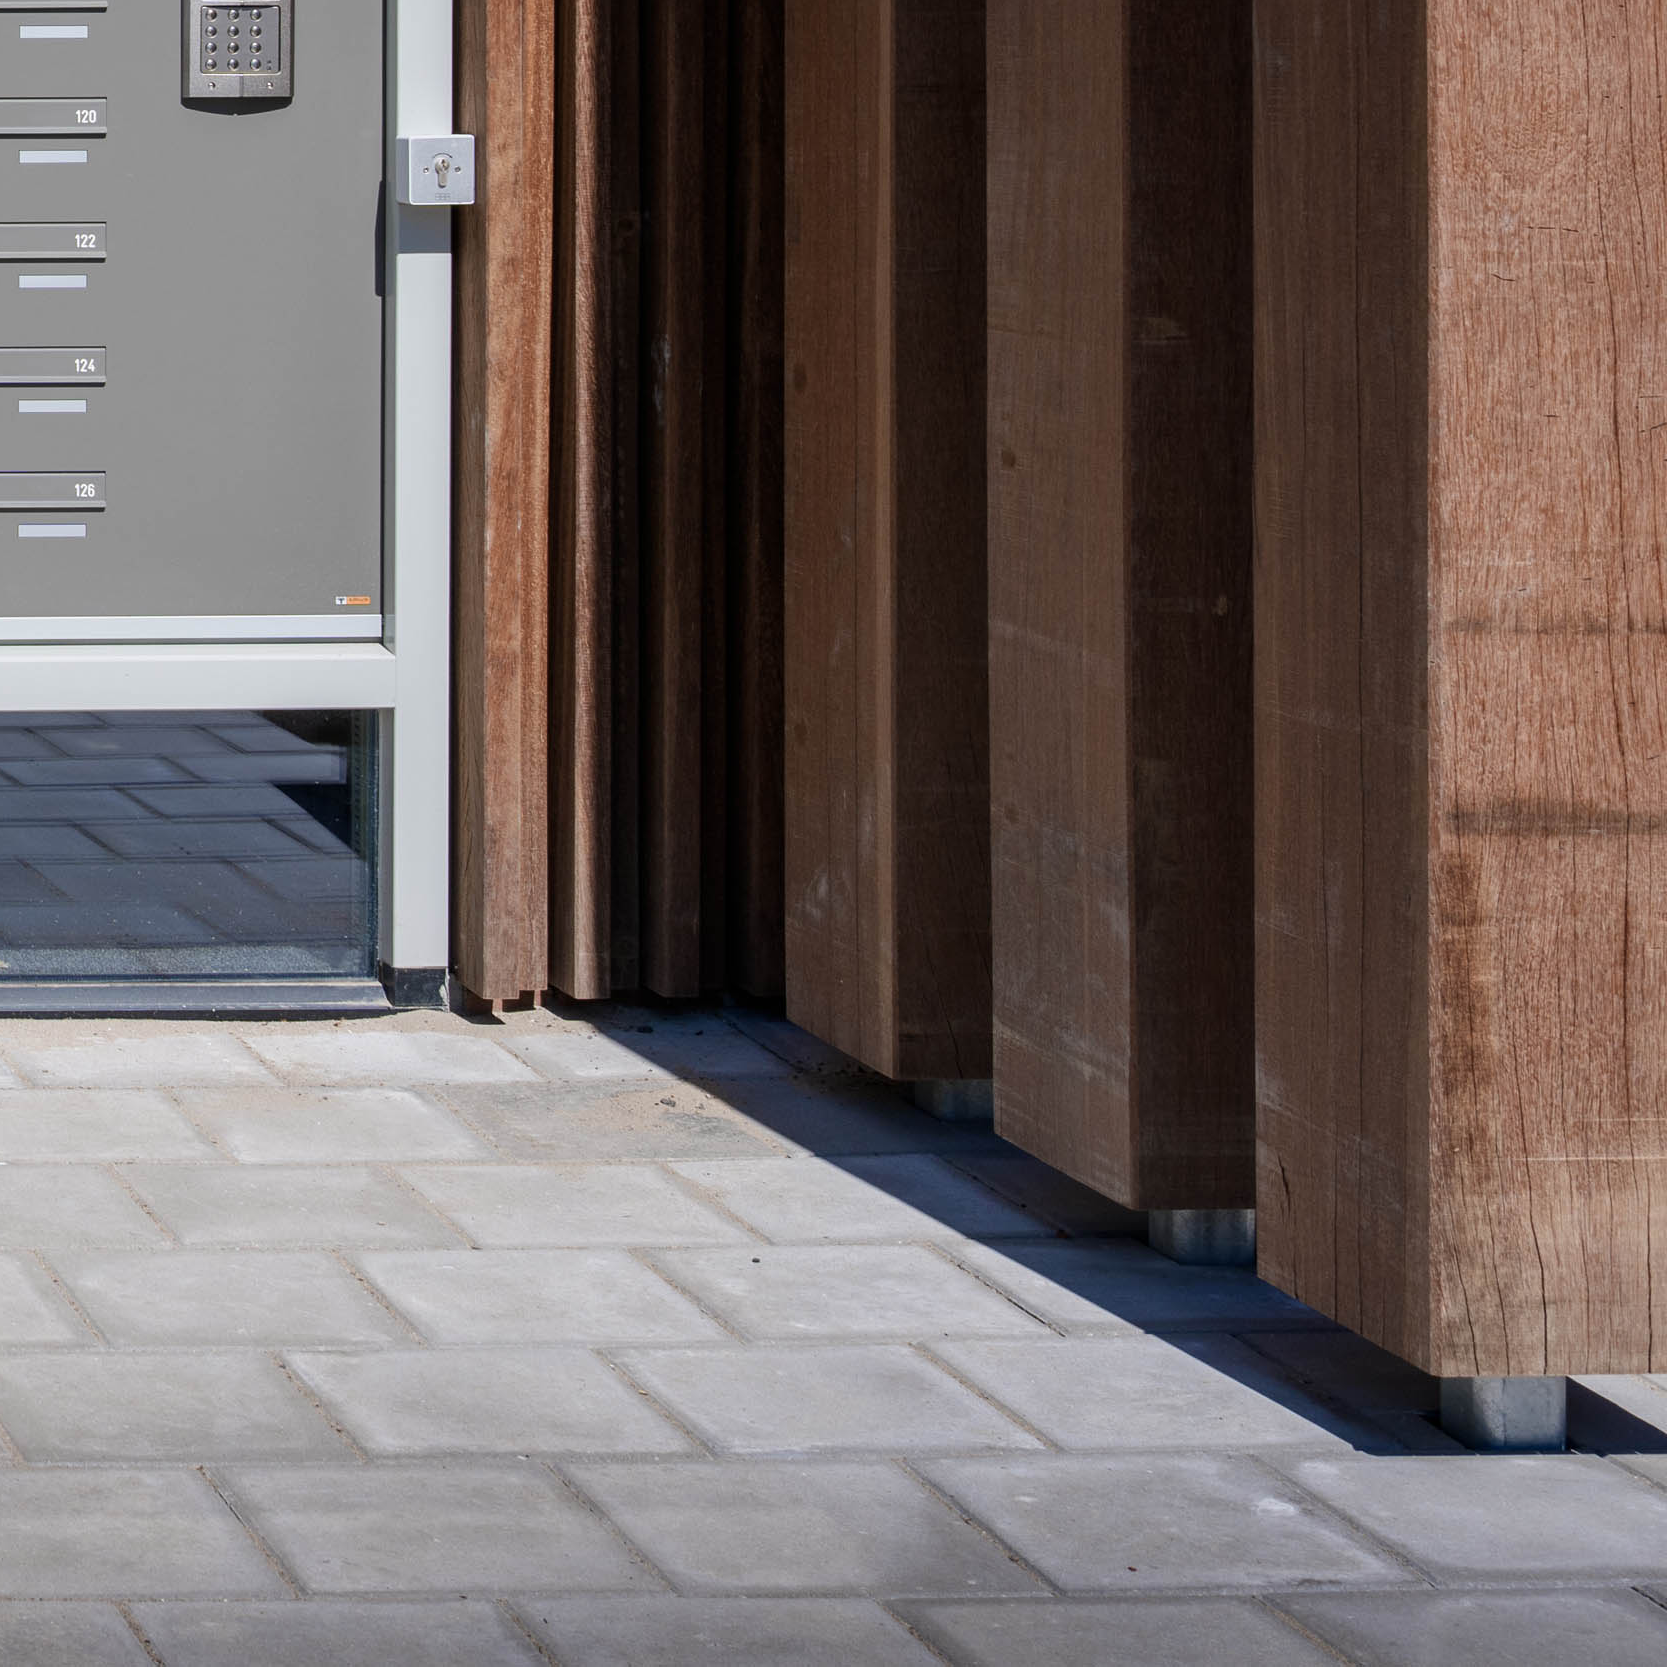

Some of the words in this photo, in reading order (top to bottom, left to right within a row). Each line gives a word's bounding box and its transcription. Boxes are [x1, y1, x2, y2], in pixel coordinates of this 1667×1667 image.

[76, 110, 96, 123] 120
[75, 234, 96, 248] 122
[75, 359, 95, 372] 124
[75, 483, 95, 497] 126
